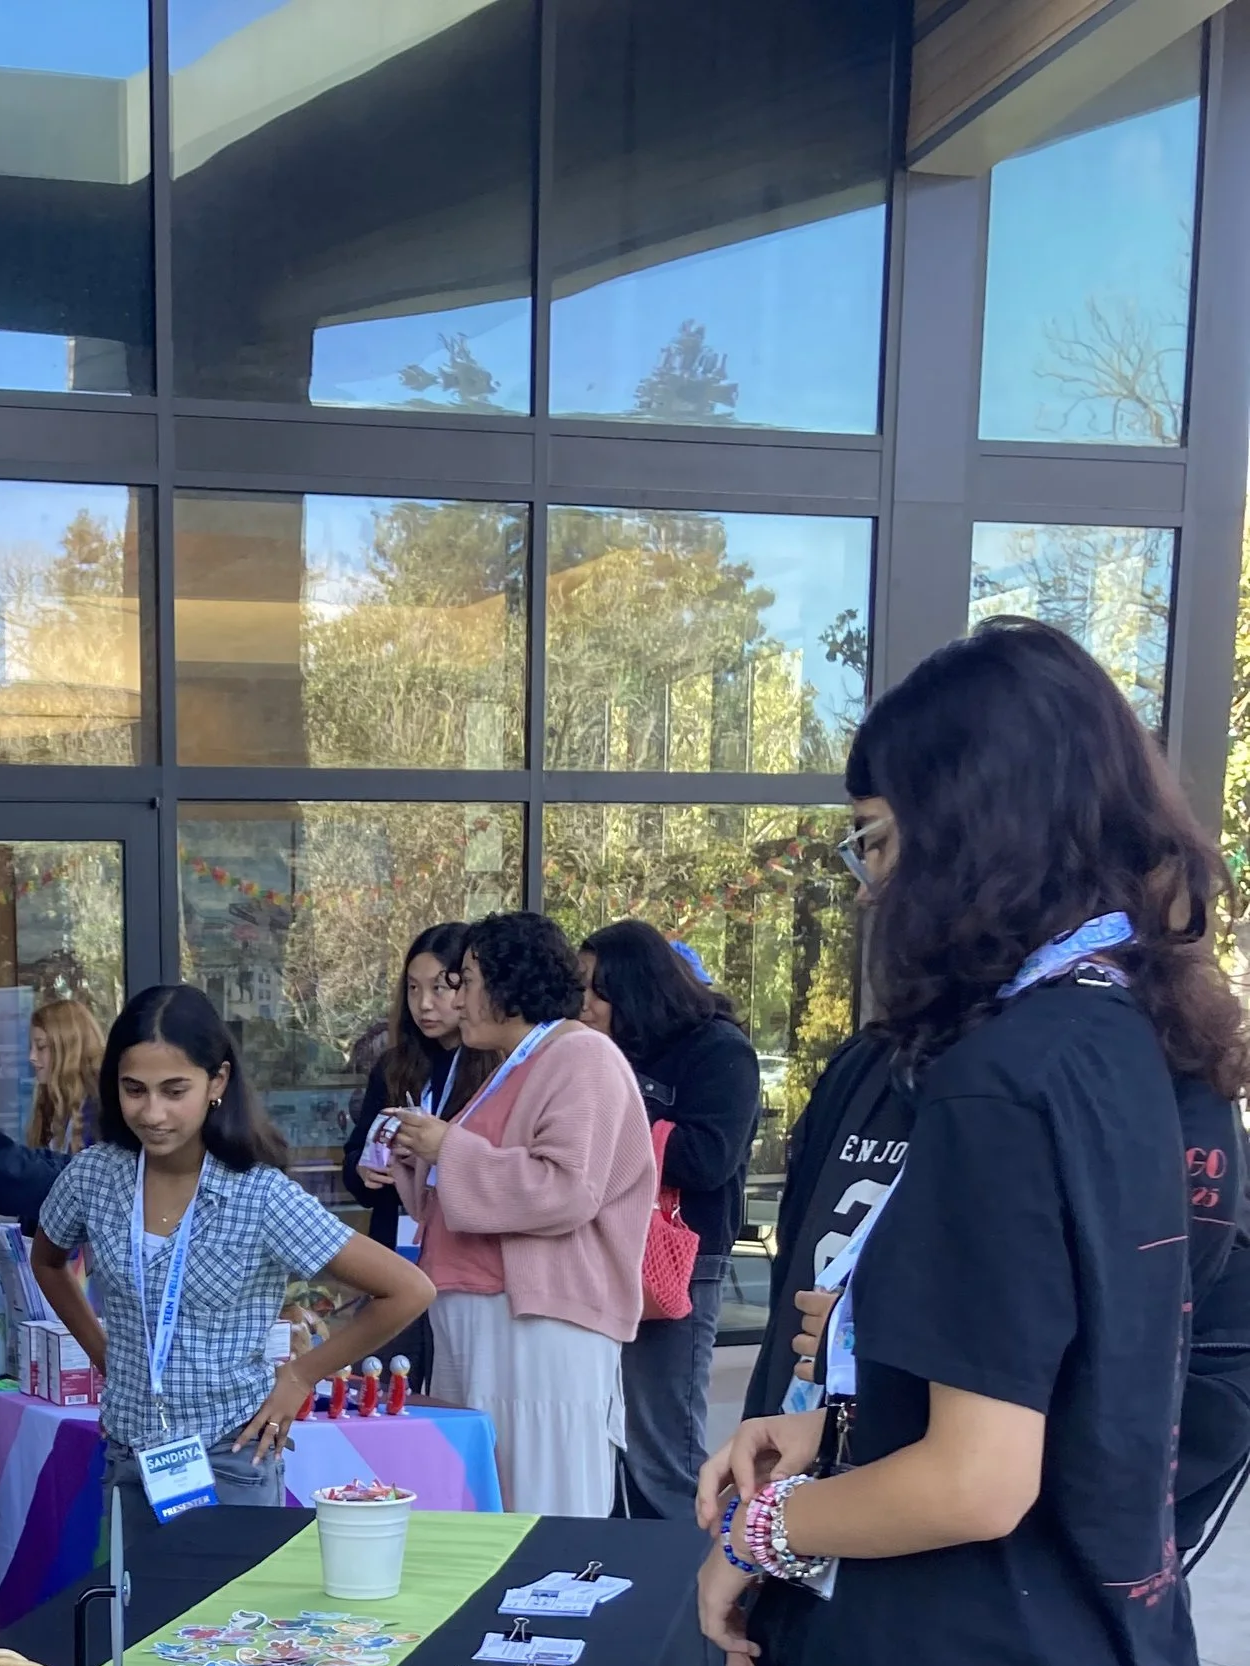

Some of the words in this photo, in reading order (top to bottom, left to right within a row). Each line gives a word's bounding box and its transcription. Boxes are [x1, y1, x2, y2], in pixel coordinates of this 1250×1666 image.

[839, 1134, 909, 1164] ENJO
[167, 1247, 184, 1299] WELLNESS
[162, 1301, 174, 1327] TEEN
[147, 1446, 203, 1470] SANDHYA
